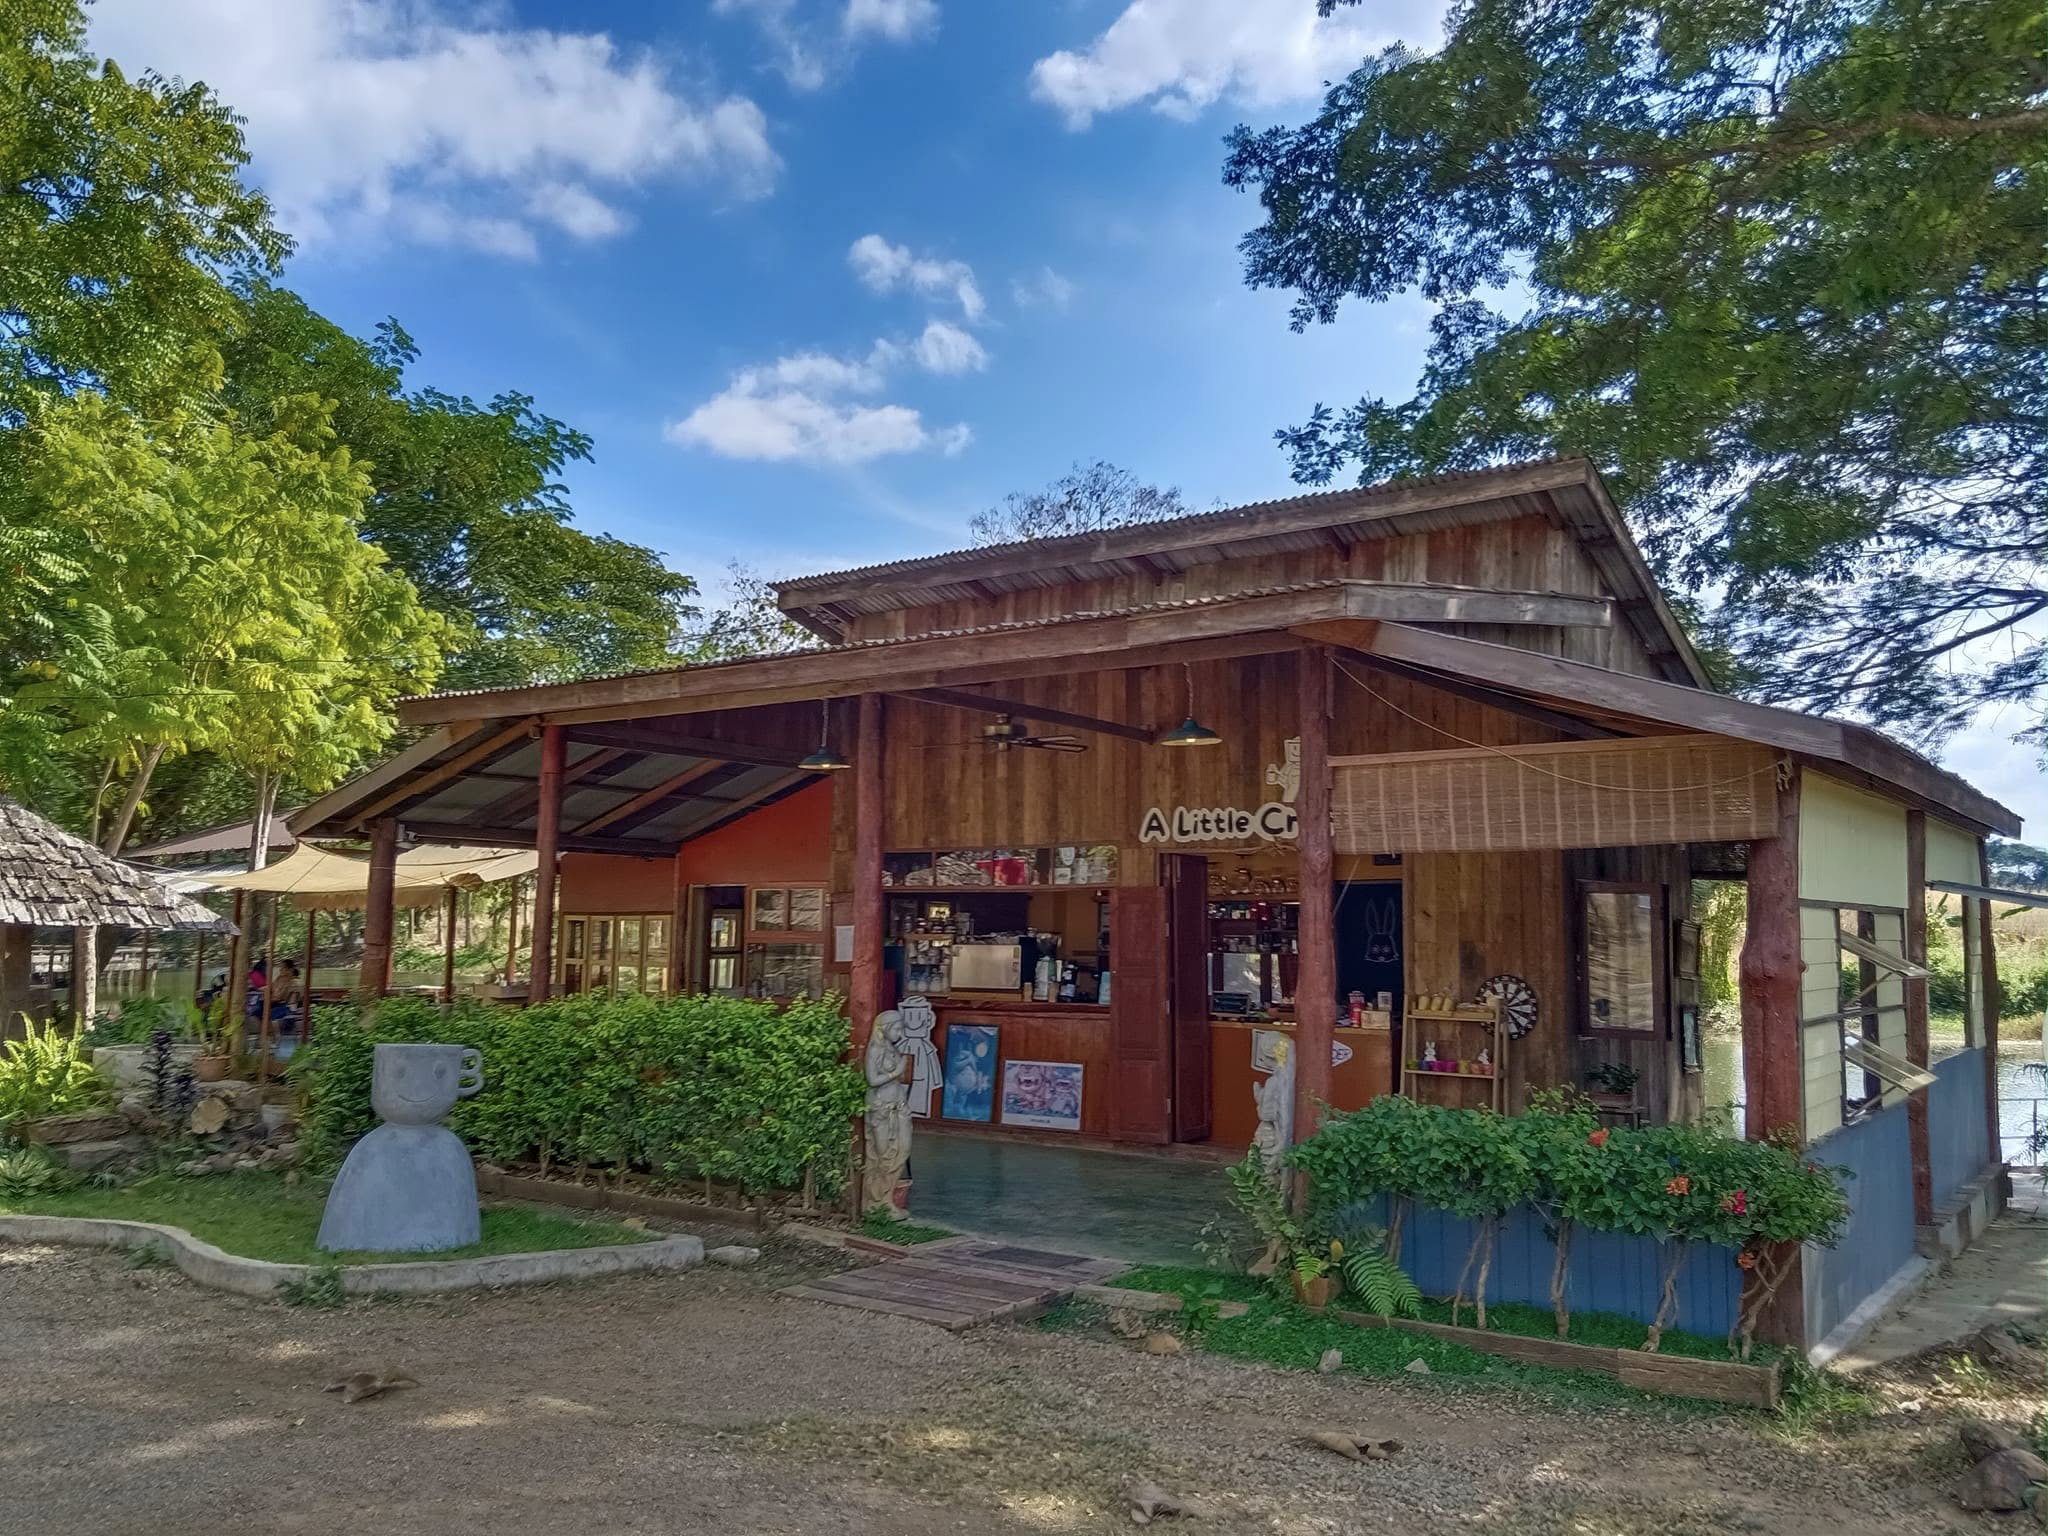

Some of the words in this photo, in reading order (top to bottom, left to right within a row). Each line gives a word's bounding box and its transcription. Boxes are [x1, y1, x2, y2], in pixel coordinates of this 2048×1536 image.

[1144, 812, 1167, 838] A
[1178, 808, 1250, 836] Little
[1260, 806, 1297, 836] Cr
